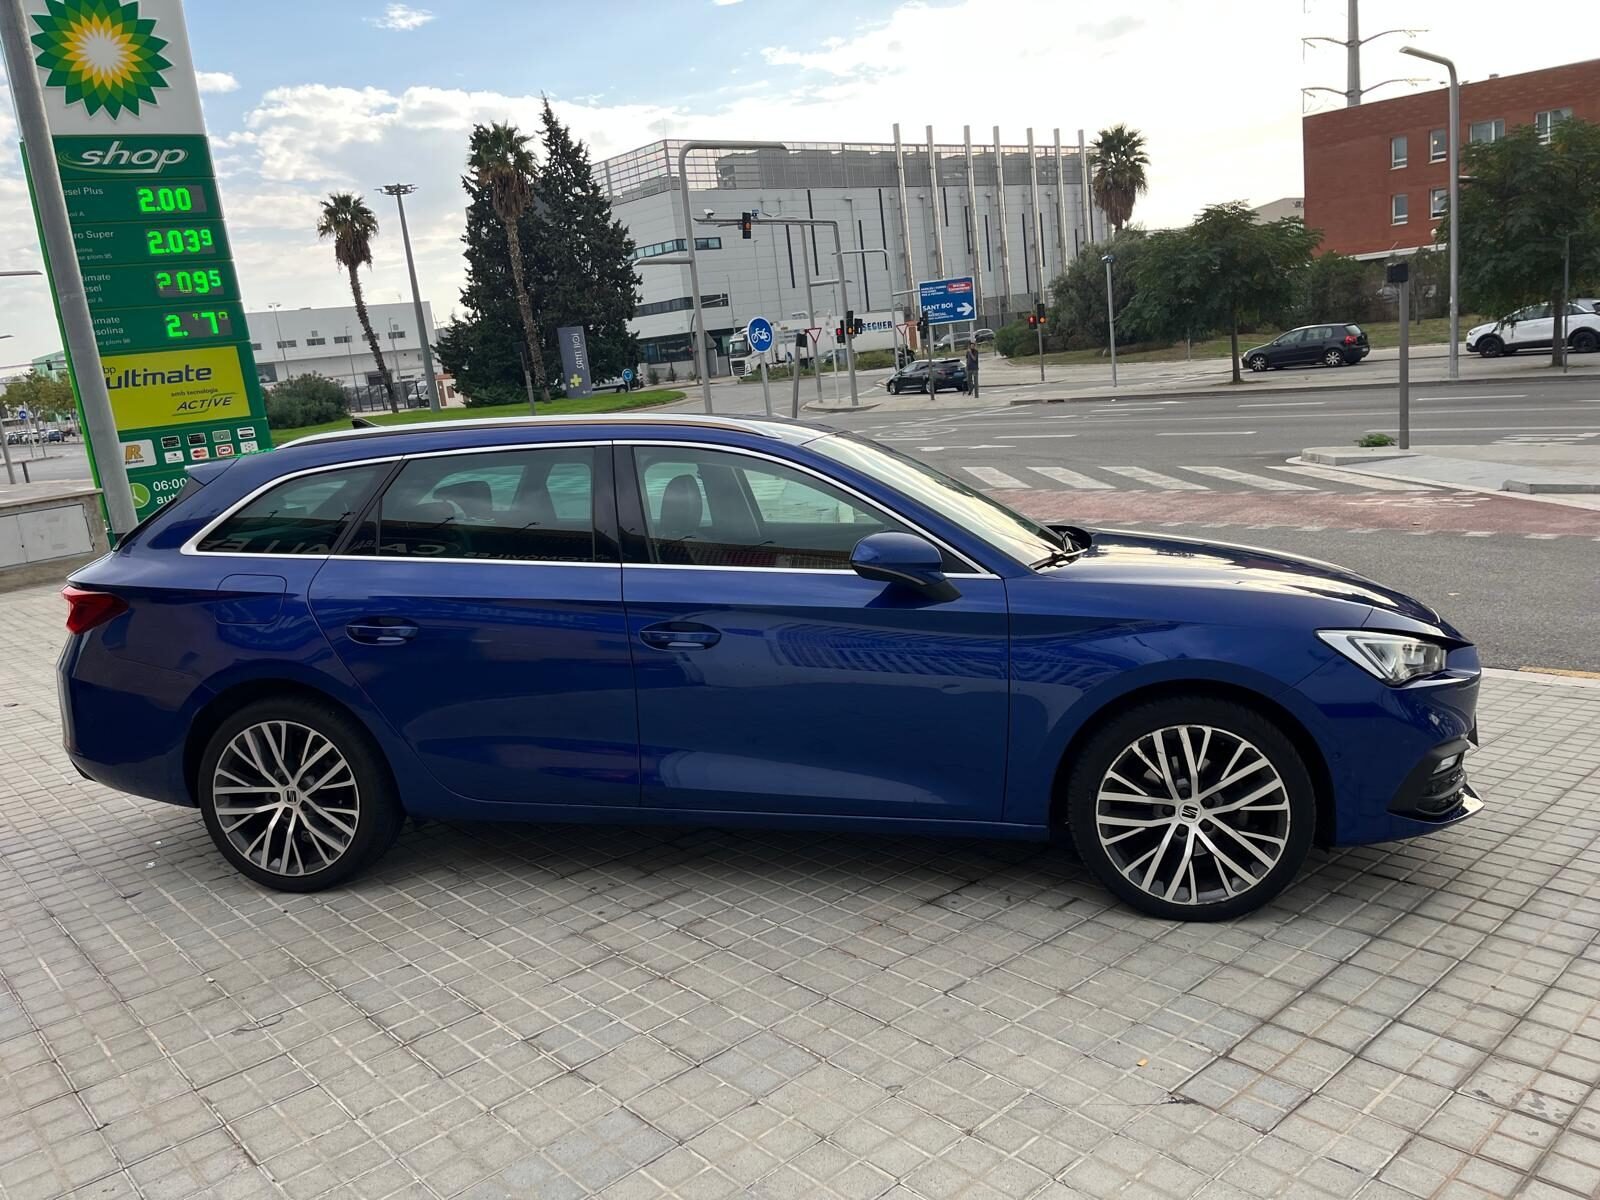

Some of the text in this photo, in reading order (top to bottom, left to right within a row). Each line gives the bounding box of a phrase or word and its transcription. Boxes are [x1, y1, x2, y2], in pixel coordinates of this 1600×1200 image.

[80, 141, 188, 173] shop
[83, 187, 104, 195] Plus
[138, 187, 192, 213] 2.00
[86, 231, 114, 239] Super
[147, 229, 212, 255] 2.039
[107, 364, 212, 390] ultimate
[187, 388, 219, 396] tecnologia
[177, 396, 233, 411] ACTIVE
